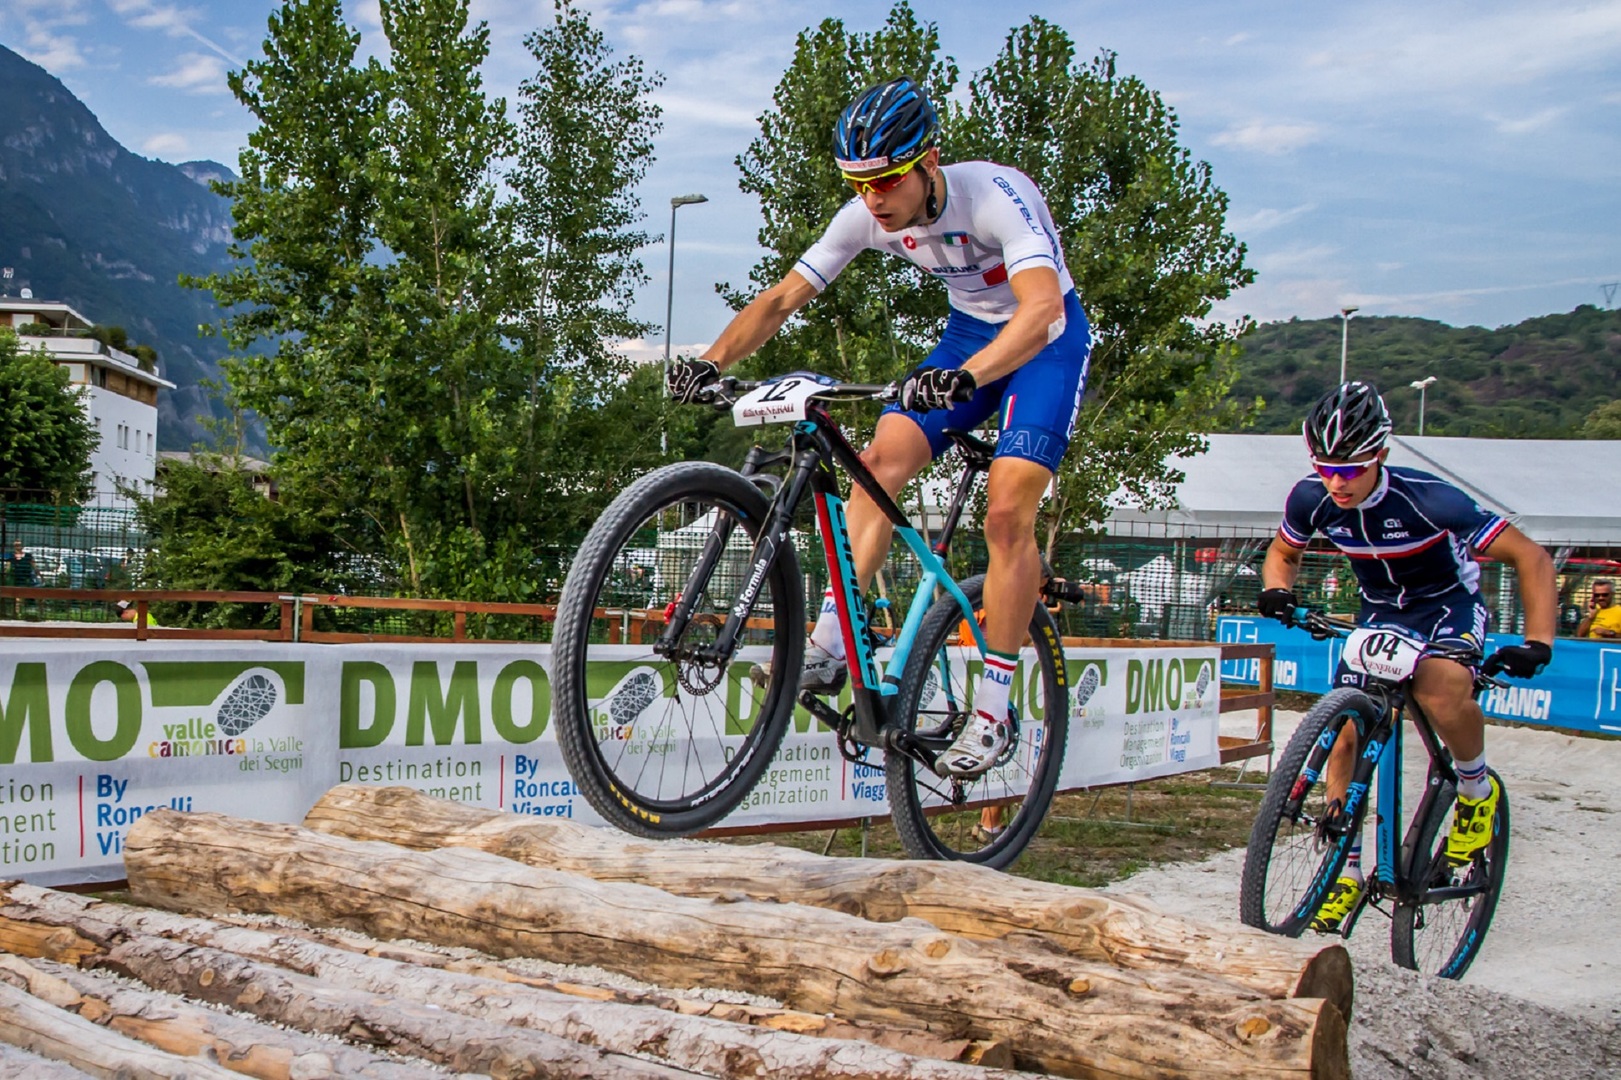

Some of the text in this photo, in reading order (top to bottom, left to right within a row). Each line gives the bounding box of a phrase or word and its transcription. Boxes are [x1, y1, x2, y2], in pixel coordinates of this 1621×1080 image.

[757, 380, 801, 402] 12
[740, 558, 768, 605] Formula
[1042, 625, 1066, 687] MAXXIS
[1366, 632, 1401, 661] 04
[1125, 658, 1183, 715] DMO
[0, 660, 142, 764] MO
[339, 659, 551, 749] DMO
[1485, 685, 1552, 720] FRANCI
[163, 718, 216, 740] valle
[148, 737, 303, 759] camonica la Valle
[239, 755, 303, 773] dei Segni
[340, 756, 482, 784] Destination
[515, 754, 539, 780] By
[97, 774, 128, 804] By
[741, 785, 829, 811] ganization
[852, 781, 887, 802] Viagg
